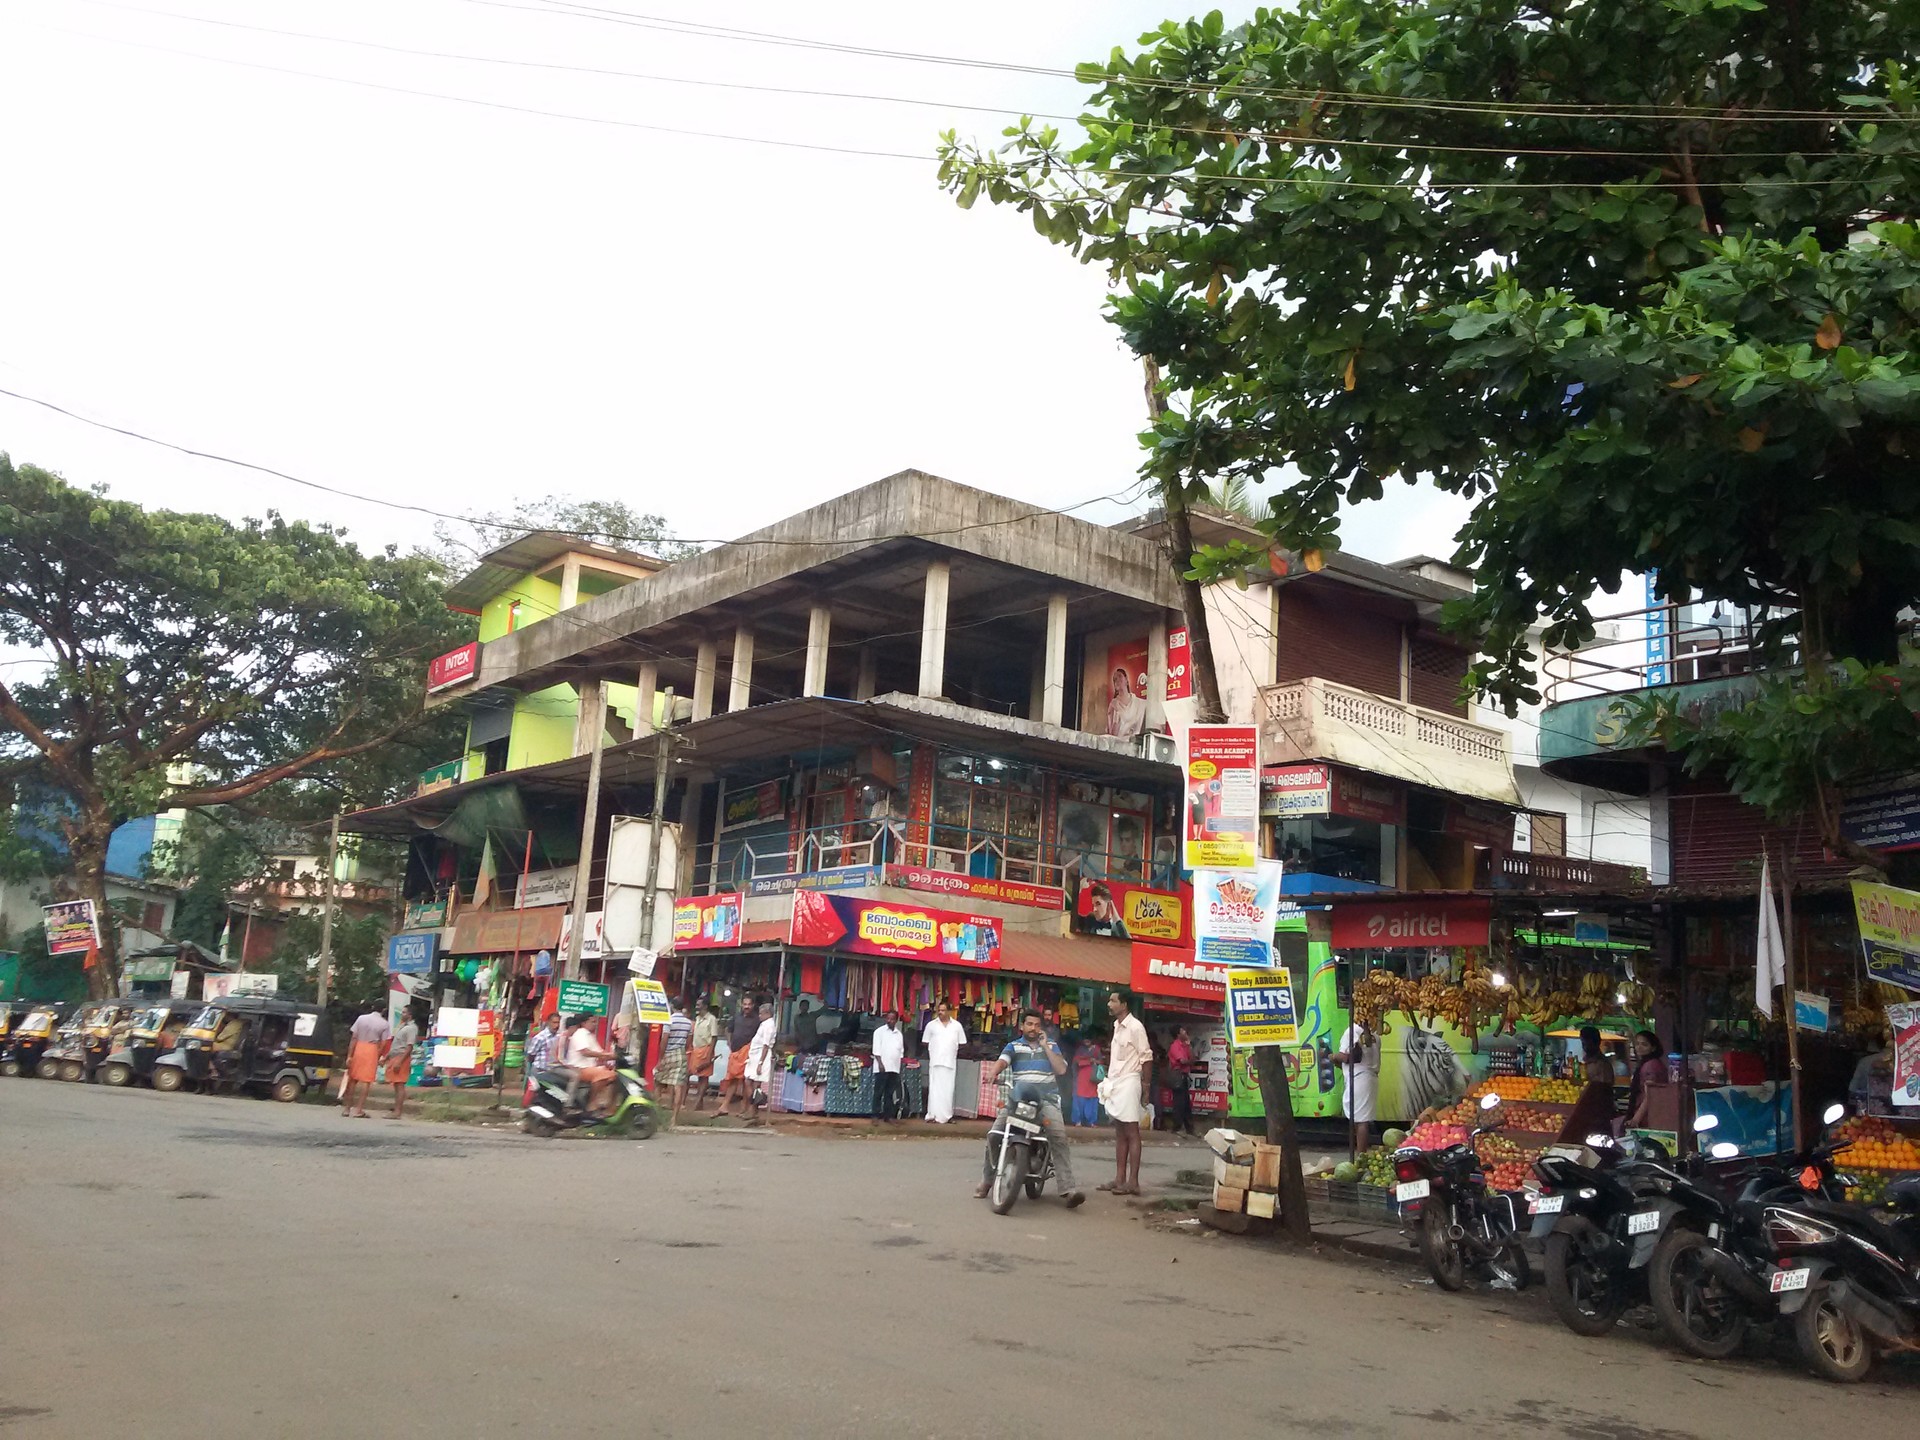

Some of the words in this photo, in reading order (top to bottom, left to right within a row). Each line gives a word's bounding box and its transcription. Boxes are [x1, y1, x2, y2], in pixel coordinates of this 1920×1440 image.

[908, 872, 970, 891] ചൈത്രം
[1135, 904, 1164, 920] Look
[866, 913, 932, 931] ബോംബെ
[1388, 911, 1449, 937] airtel
[865, 925, 933, 944] വസ്ത്രമേള
[394, 943, 426, 960] NOKIA
[1192, 983, 1209, 991] Sales
[1232, 977, 1253, 987] Study
[1254, 976, 1282, 985] ABROAD
[1284, 976, 1288, 984] ?
[1234, 989, 1291, 1011] IELTS
[1237, 1013, 1265, 1023] @EDEX
[1194, 1092, 1220, 1103] Mobile
